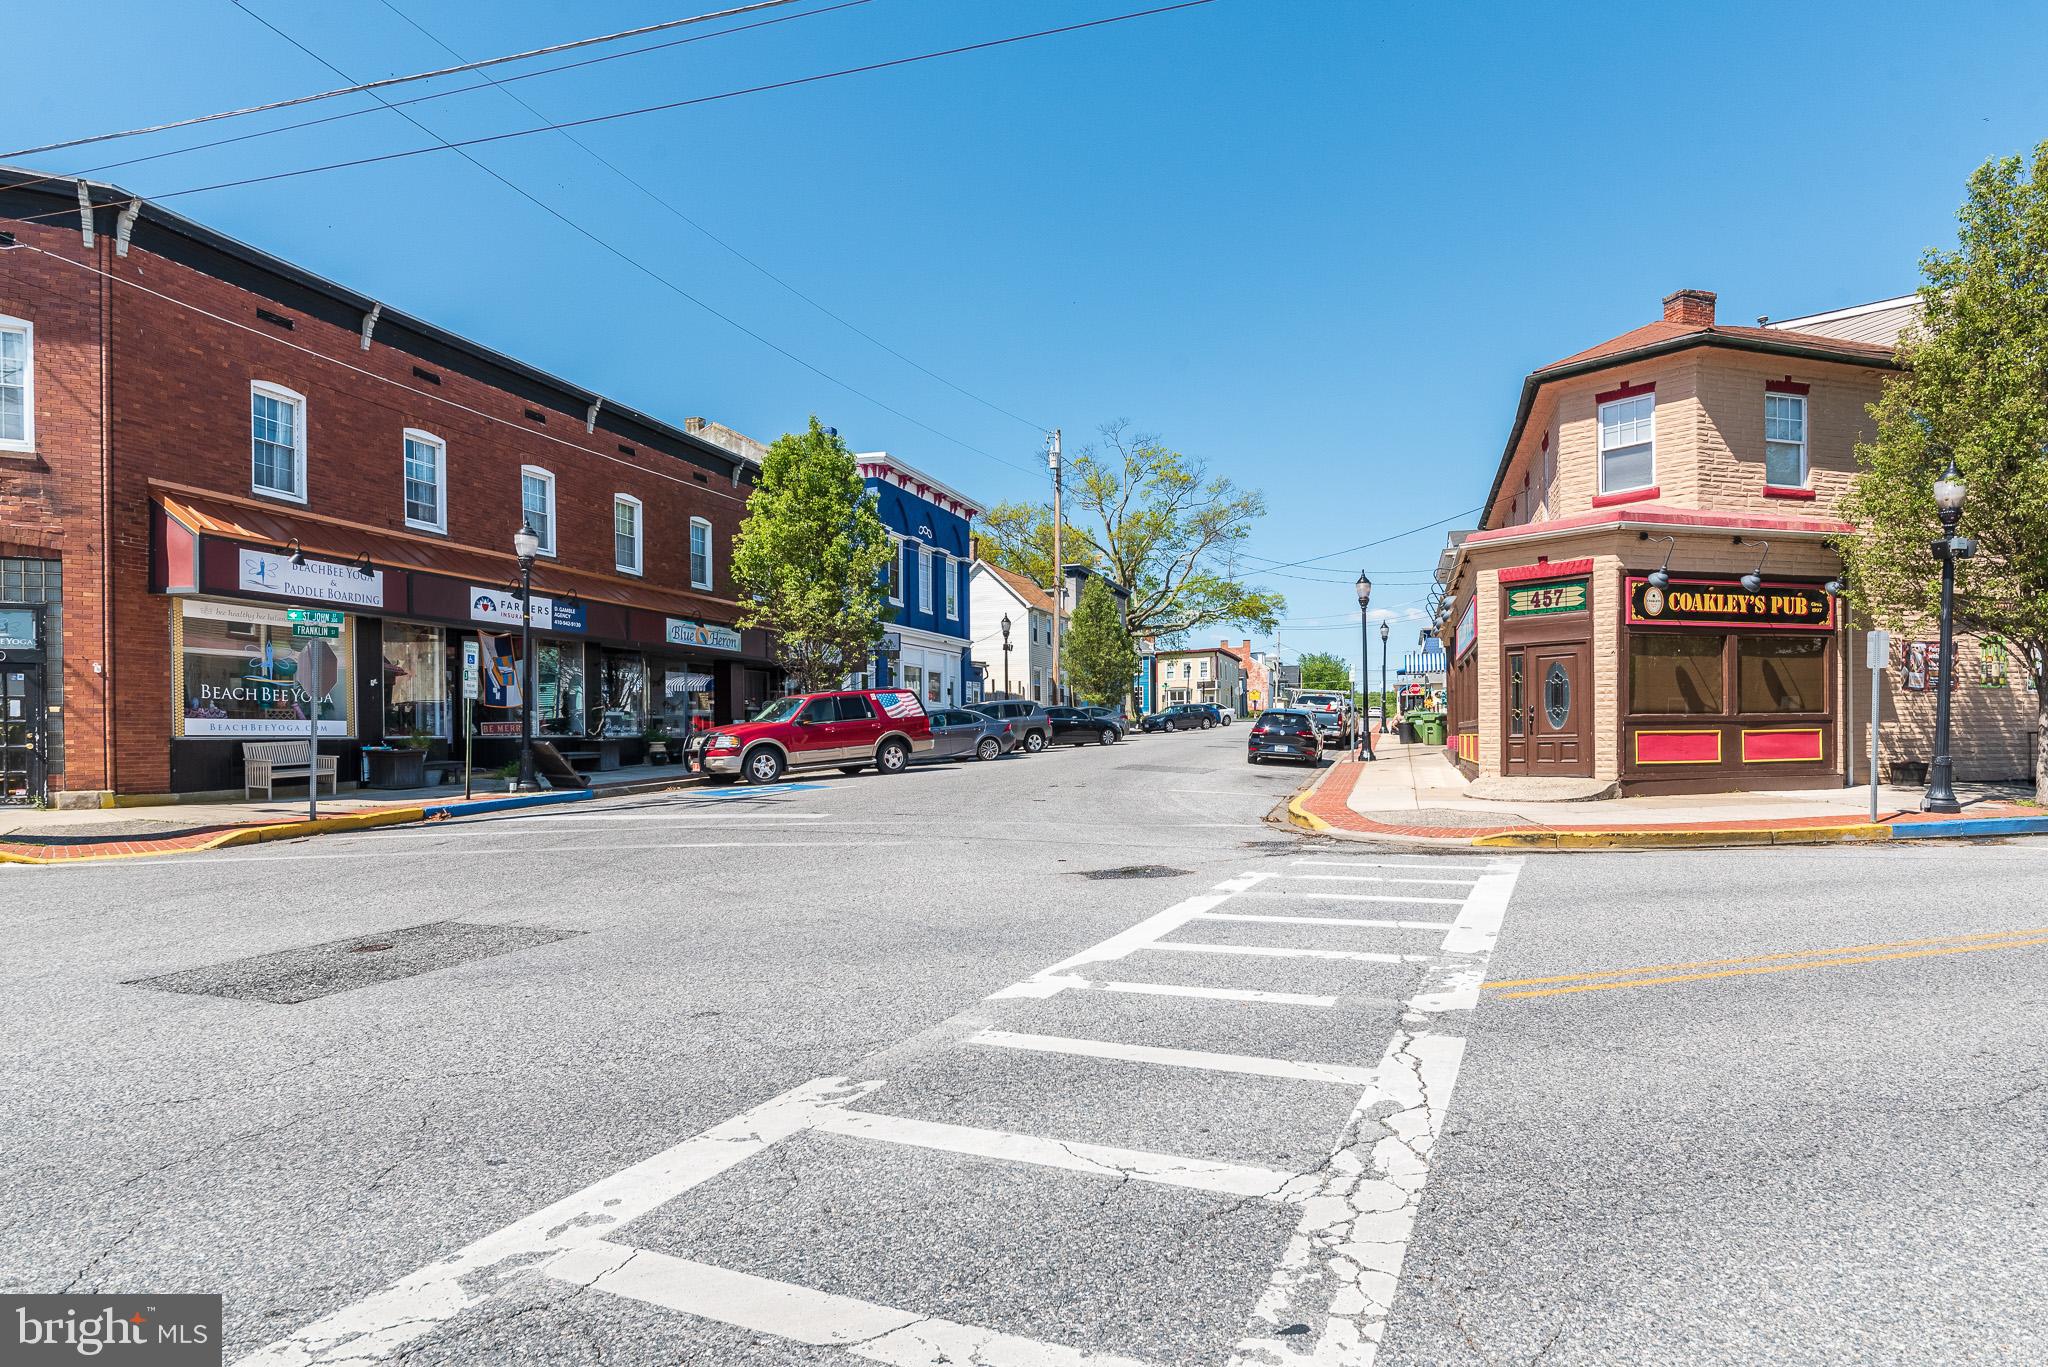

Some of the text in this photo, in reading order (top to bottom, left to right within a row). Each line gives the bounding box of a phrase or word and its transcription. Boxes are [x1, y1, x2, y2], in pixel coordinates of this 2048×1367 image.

[284, 582, 380, 605] PADDLE BOARDING
[1530, 588, 1564, 608] 457
[501, 601, 550, 615] FARERS
[1668, 592, 1766, 614] COAKLEY'S
[1771, 596, 1808, 616] PUB
[313, 613, 329, 621] JOHN
[501, 612, 534, 621] INSURAE
[298, 626, 328, 635] FRANKLIN
[672, 624, 737, 648] Blue Heron
[201, 684, 257, 701] BEACH
[483, 725, 522, 733] BE MERR
